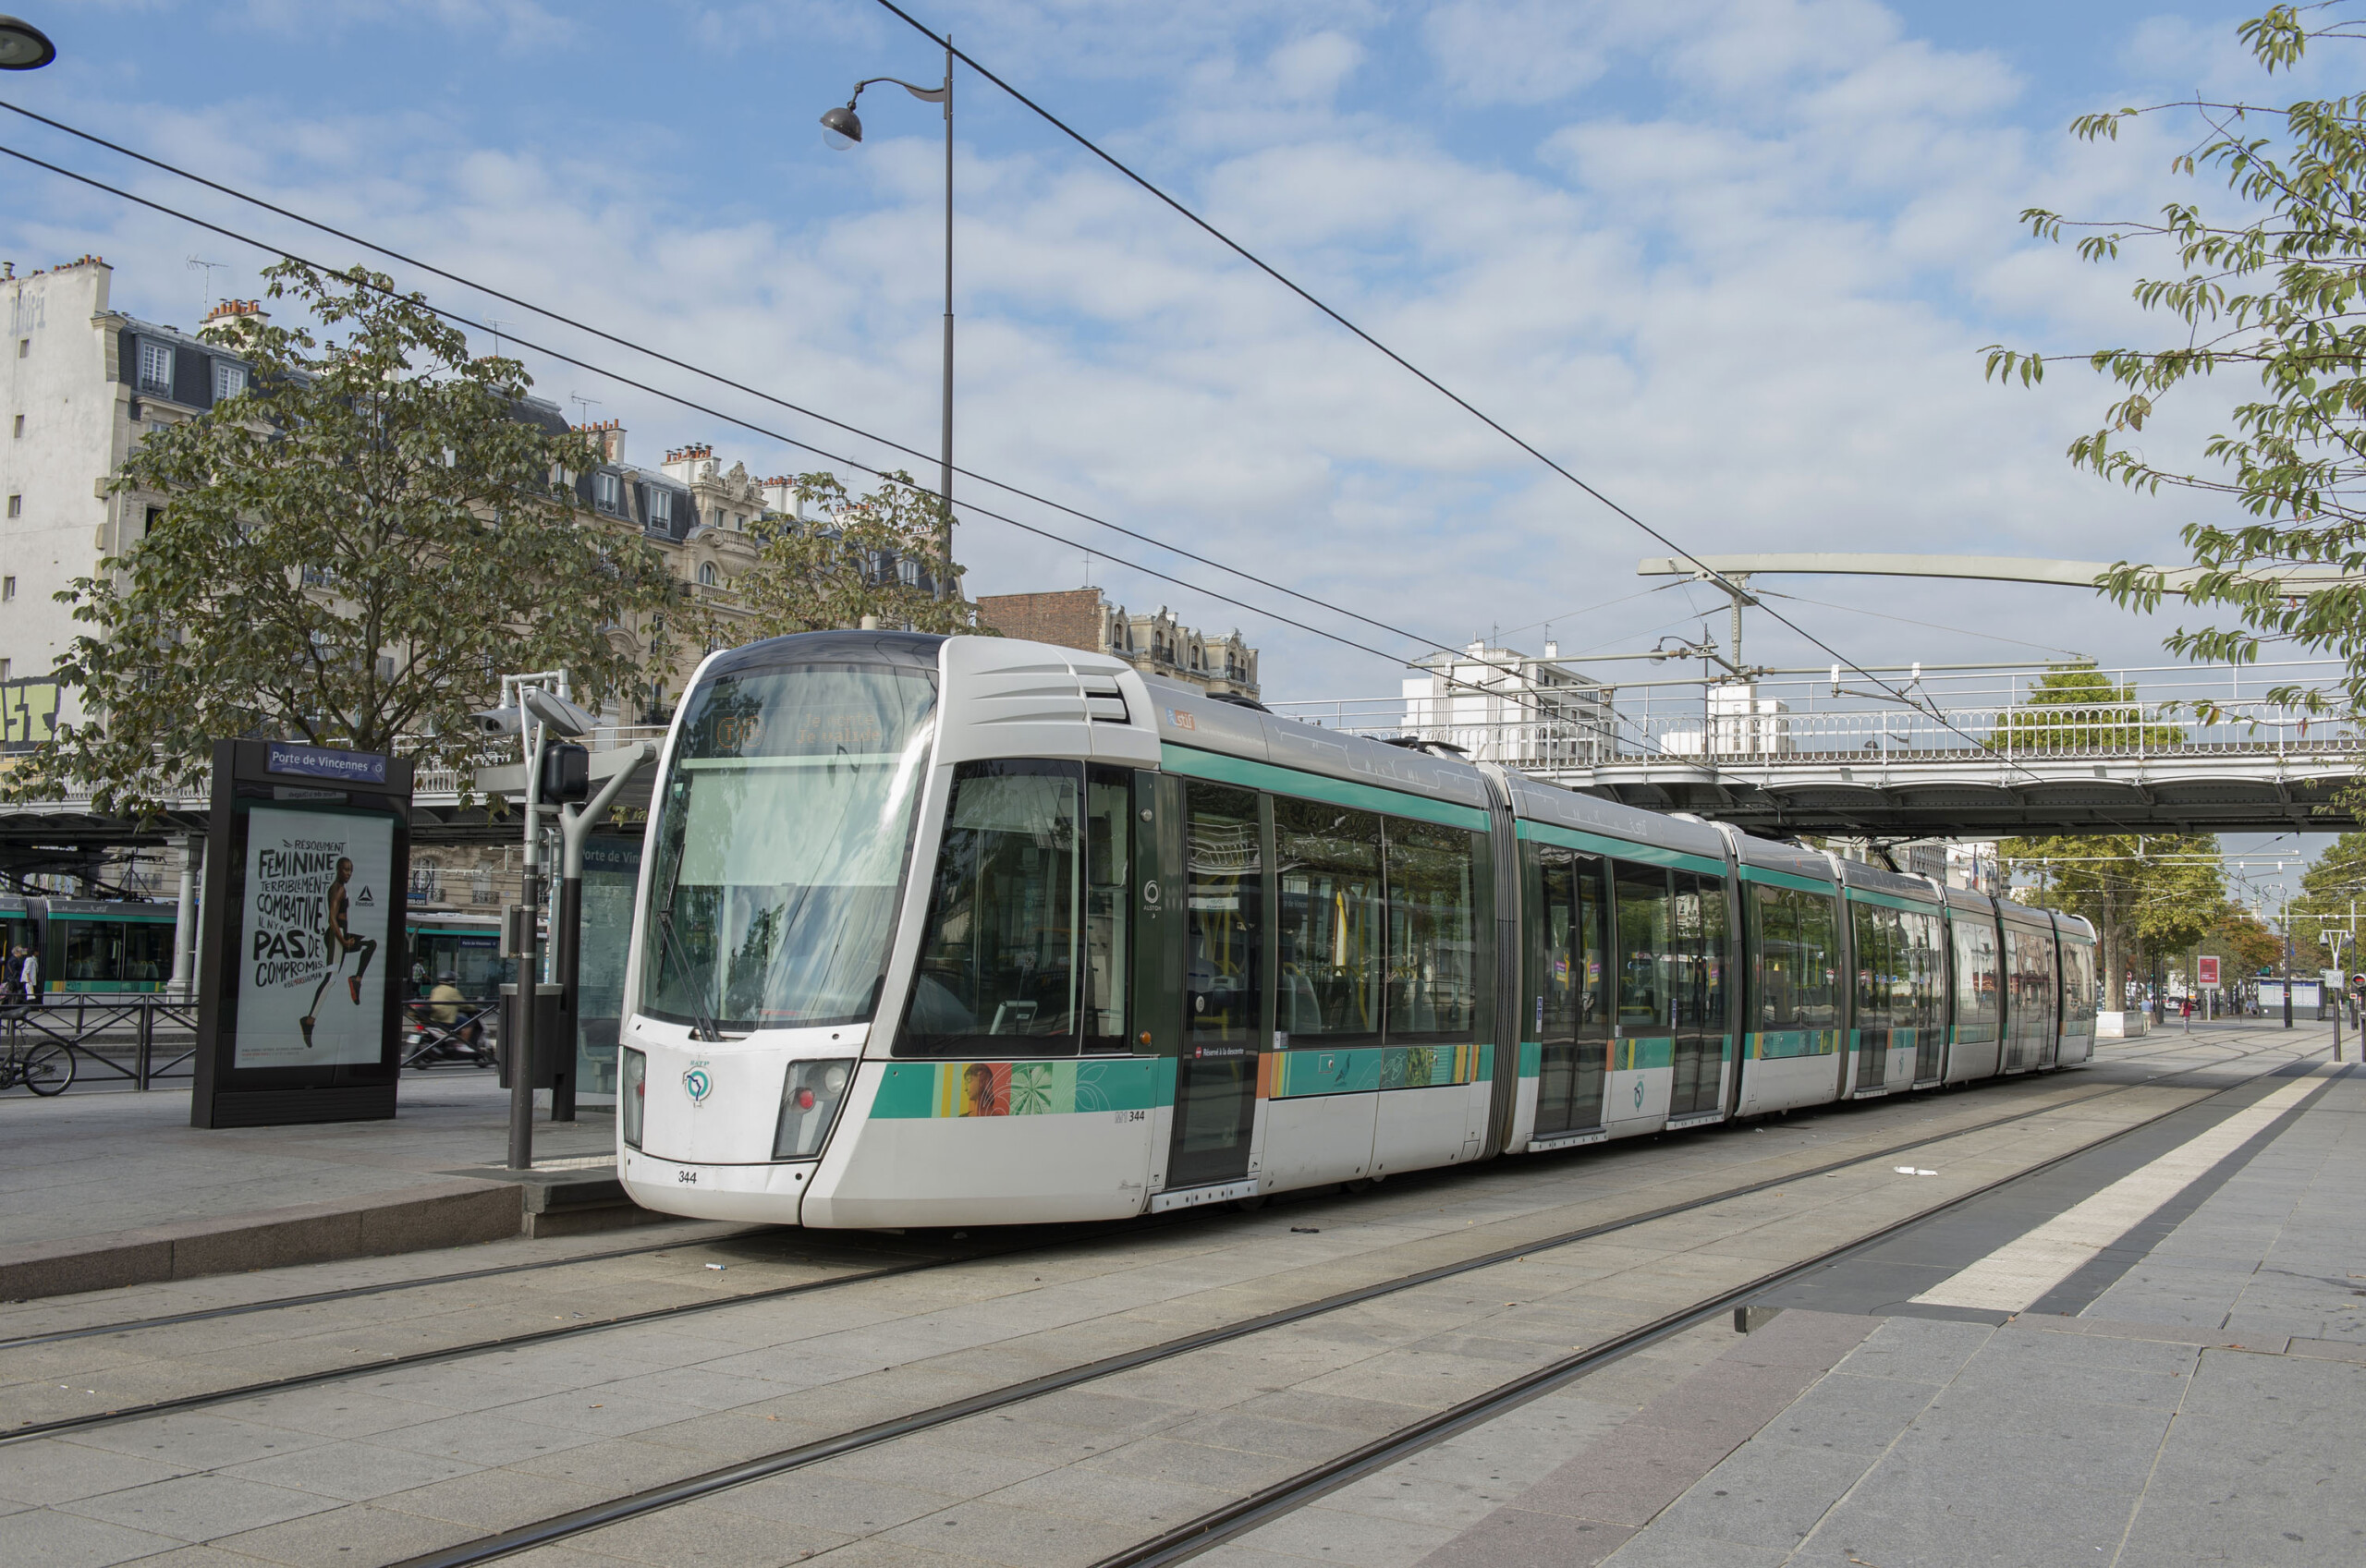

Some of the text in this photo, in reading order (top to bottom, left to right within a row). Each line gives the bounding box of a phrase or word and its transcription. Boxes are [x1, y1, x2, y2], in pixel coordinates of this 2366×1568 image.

[272, 751, 368, 772] Porte de Vincennes
[583, 849, 605, 862] orte
[607, 850, 620, 863] de
[259, 849, 339, 880] FÉMININE
[261, 875, 331, 894] TERRIBLEMENT
[253, 930, 321, 961] PAS DE
[1202, 1047, 1219, 1057] Réservé
[1227, 1046, 1244, 1055] descente
[1128, 1111, 1145, 1123] 344
[678, 1170, 697, 1184] 344
